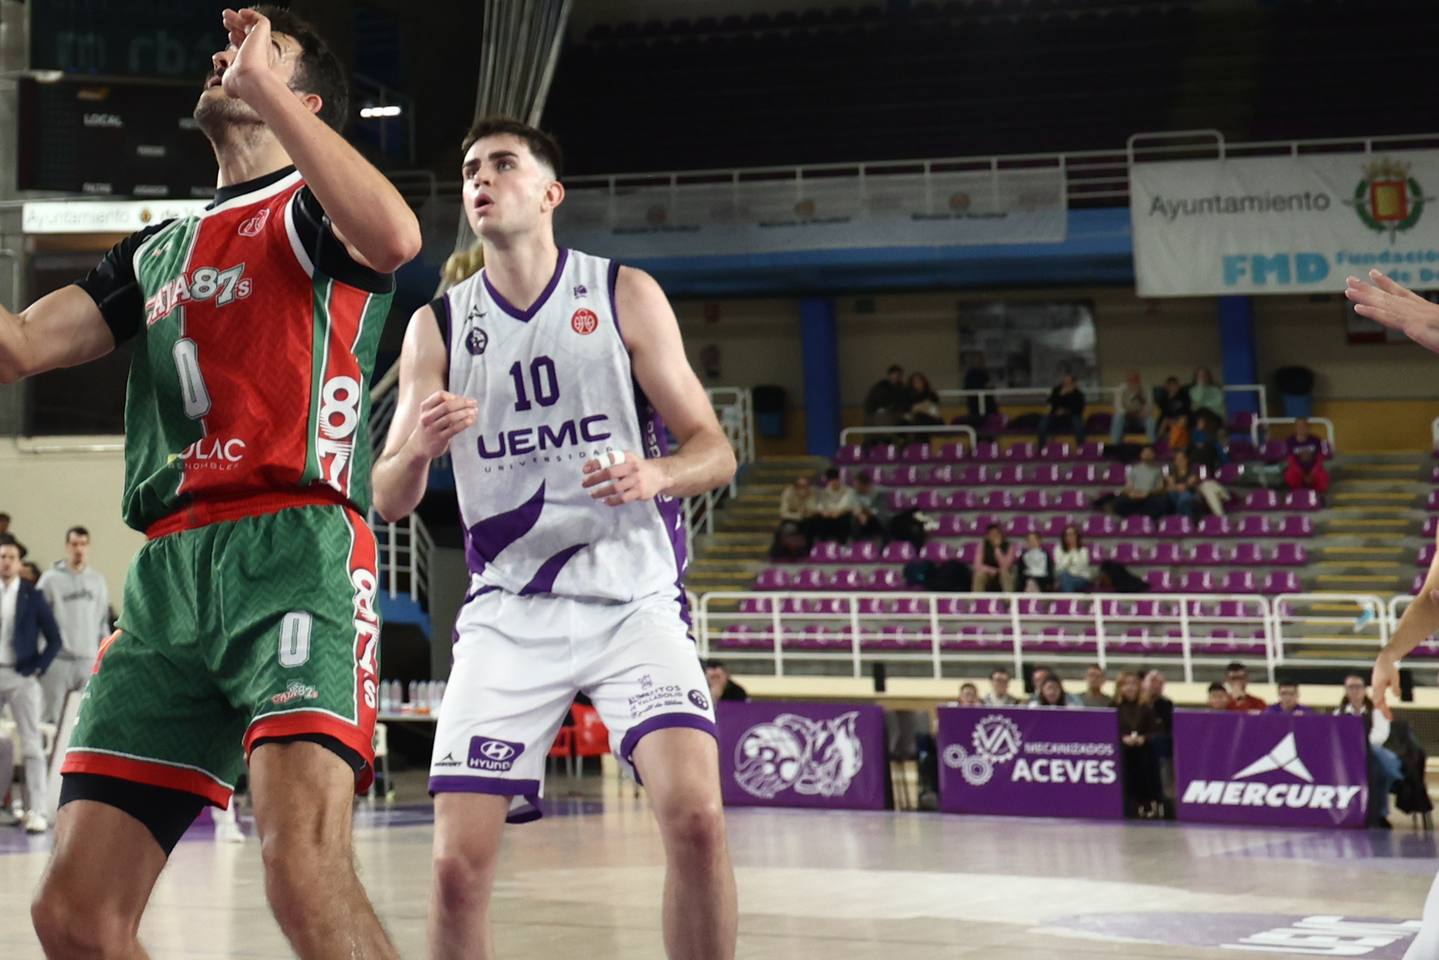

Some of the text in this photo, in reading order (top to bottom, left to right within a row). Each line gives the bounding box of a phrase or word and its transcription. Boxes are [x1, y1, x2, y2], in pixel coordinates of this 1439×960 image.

[82, 112, 124, 128] LOCAL
[1148, 189, 1331, 224] Ayuntamiento
[1222, 252, 1331, 286] FMD
[509, 355, 560, 413] 10
[477, 413, 612, 460] UEMC
[483, 445, 614, 473] UNIVERSIDAD
[278, 609, 313, 669] 0
[1011, 758, 1117, 785] ACEVES
[1182, 779, 1363, 810] MERCURY
